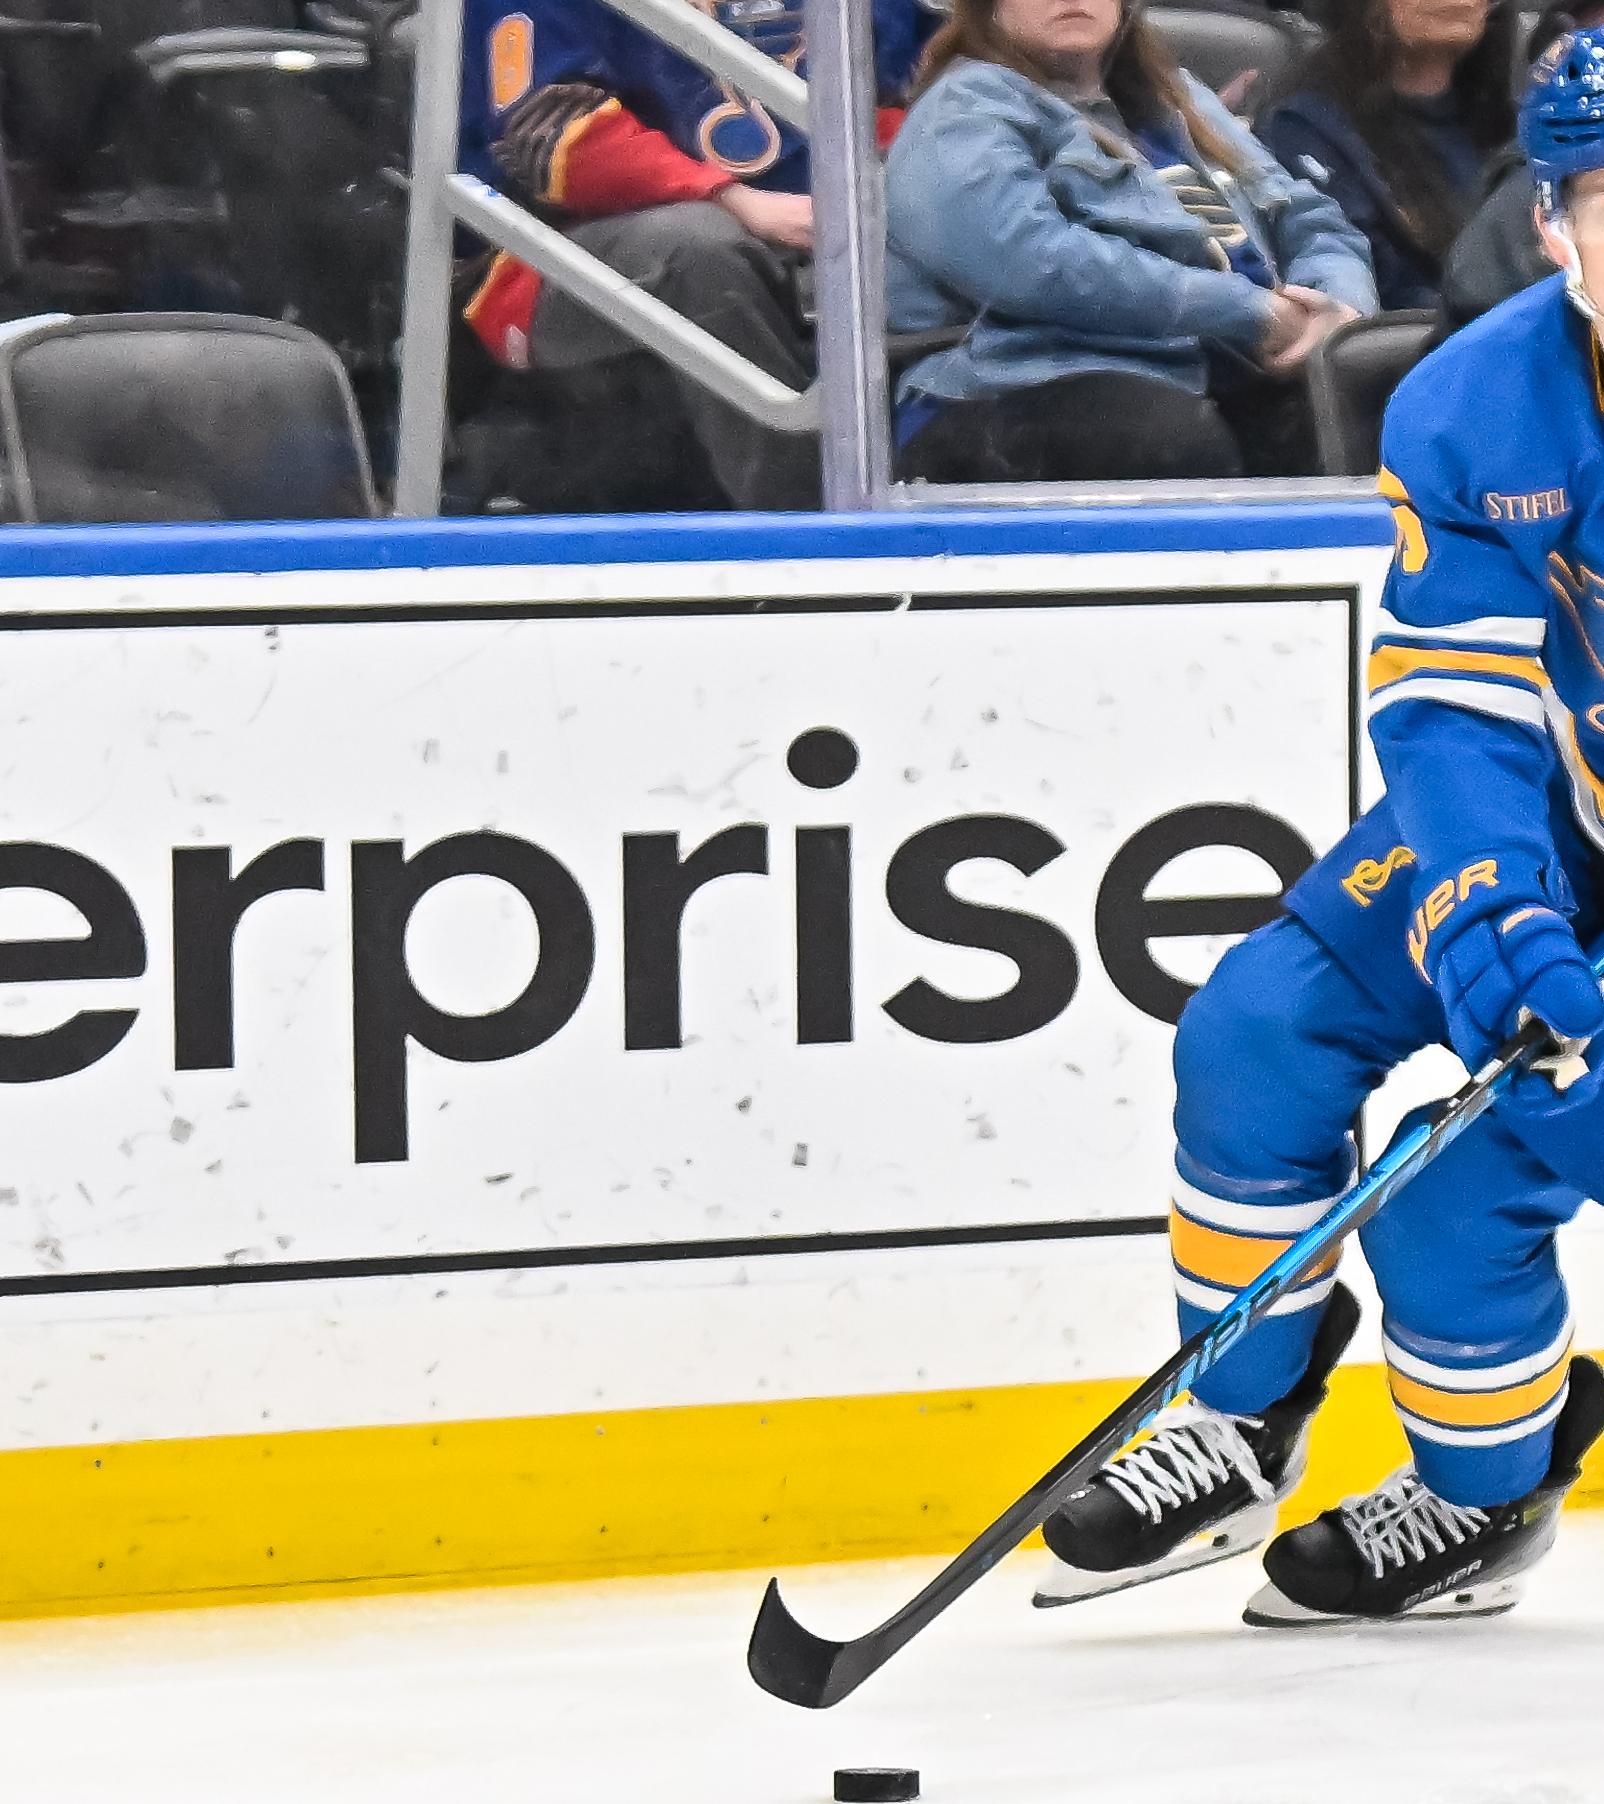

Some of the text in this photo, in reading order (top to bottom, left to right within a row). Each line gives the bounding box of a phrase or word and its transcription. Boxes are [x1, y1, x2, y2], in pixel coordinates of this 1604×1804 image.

[1484, 487, 1573, 521] STIFEL
[0, 727, 1322, 1164] erprise
[1408, 859, 1500, 986] UER
